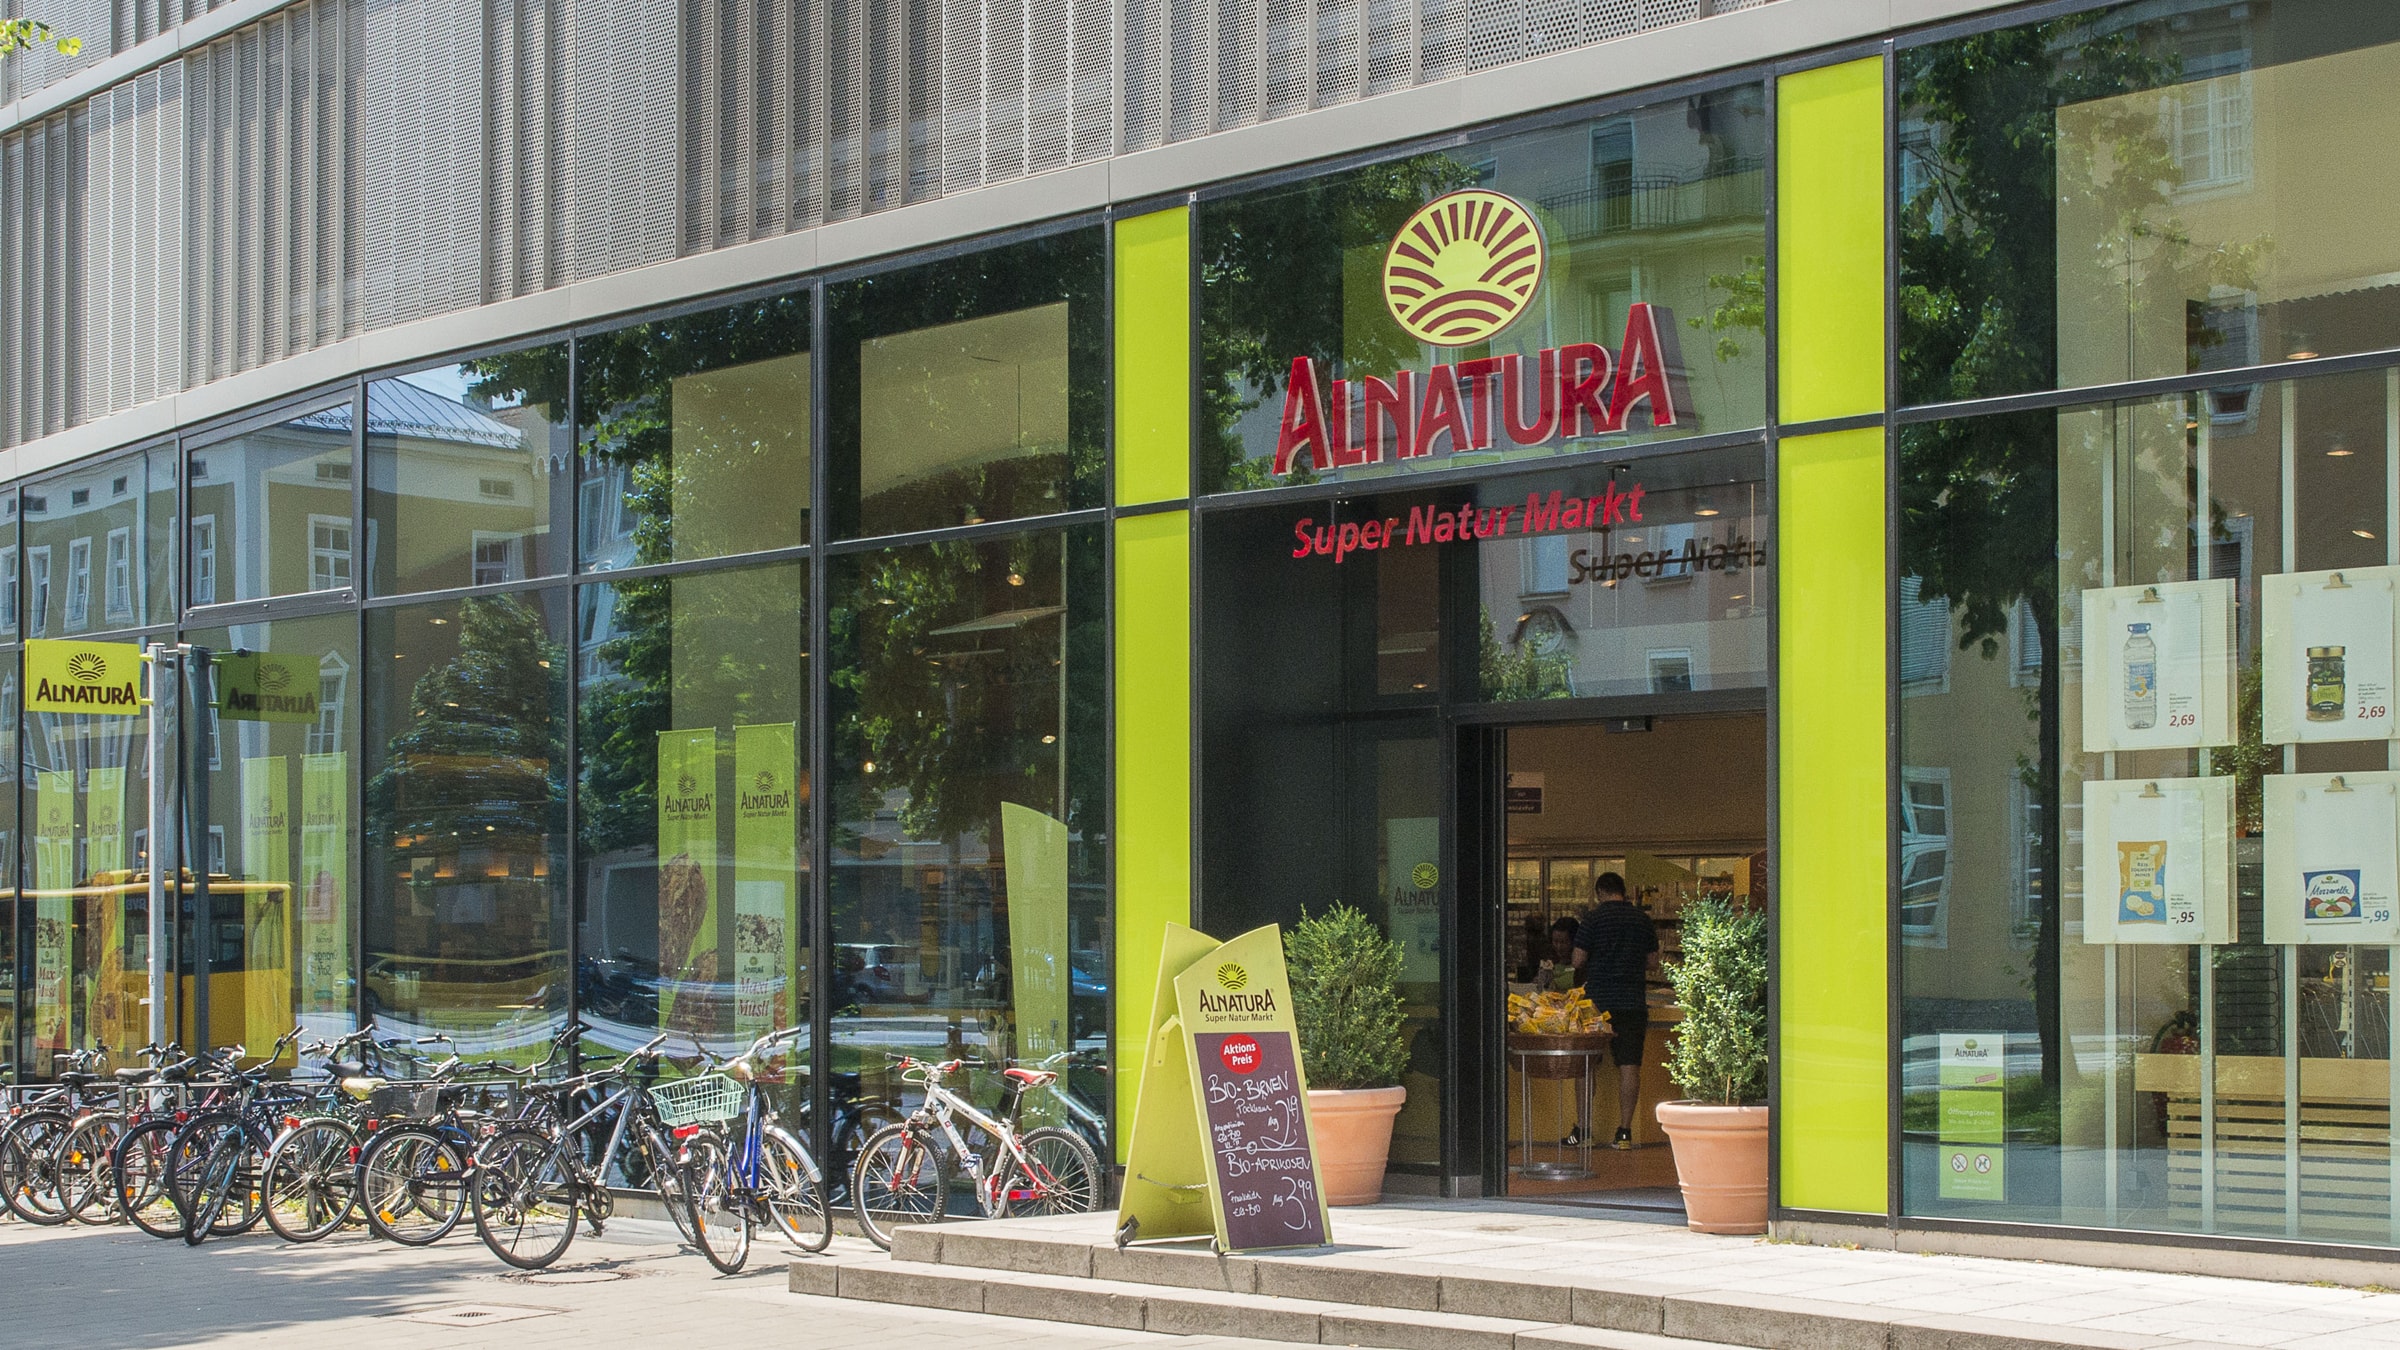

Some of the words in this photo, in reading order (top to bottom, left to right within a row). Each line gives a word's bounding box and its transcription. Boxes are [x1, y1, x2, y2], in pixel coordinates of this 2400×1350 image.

[1273, 302, 1677, 476] ALNATURA
[1292, 517, 1399, 564] Super
[1405, 501, 1517, 546] Natur
[1521, 481, 1647, 534] Markt
[36, 678, 137, 705] ALNATURA
[2169, 713, 2196, 728] 2,69
[2358, 705, 2386, 720] 2,69
[664, 793, 711, 812] ALNATURA
[741, 790, 790, 810] ALNATURA
[1199, 988, 1277, 1013] ALNATURA
[1205, 1013, 1227, 1024] Super
[1228, 1013, 1250, 1023] Natur
[1251, 1013, 1274, 1022] Markt
[1223, 1043, 1256, 1055] Aktions
[1232, 1053, 1253, 1066] Preis
